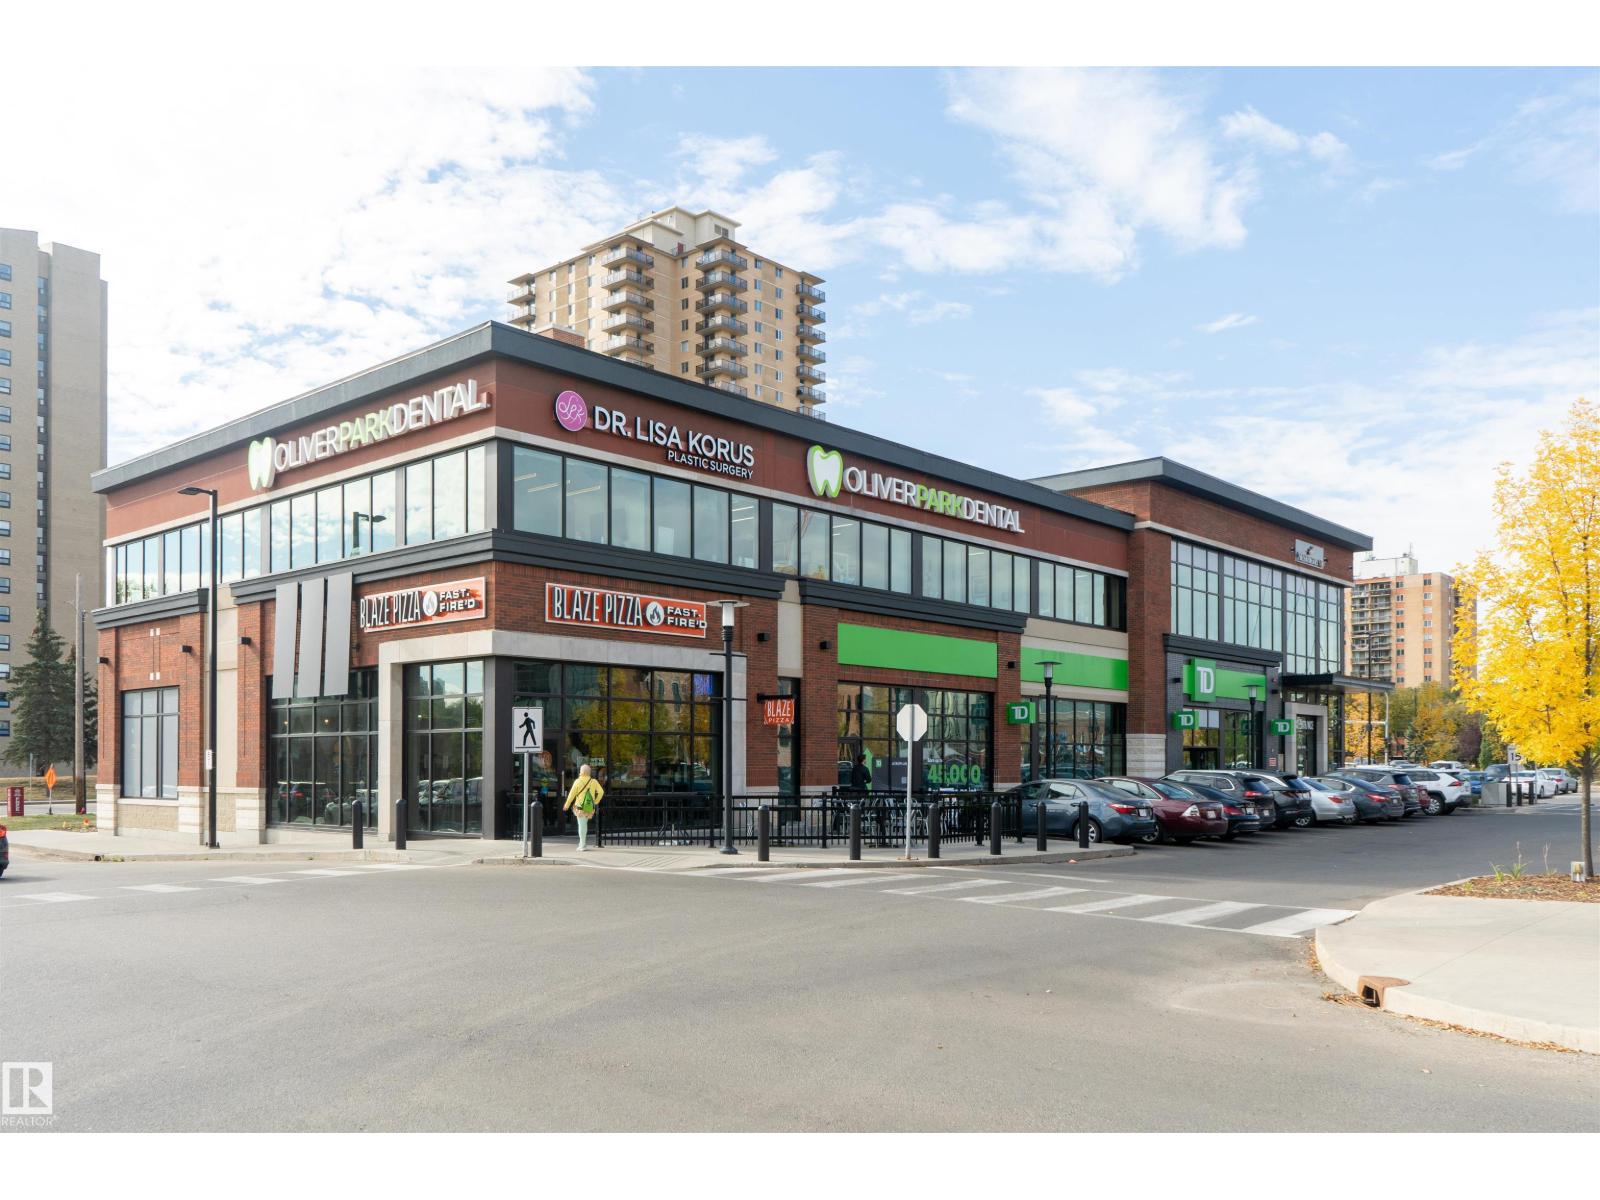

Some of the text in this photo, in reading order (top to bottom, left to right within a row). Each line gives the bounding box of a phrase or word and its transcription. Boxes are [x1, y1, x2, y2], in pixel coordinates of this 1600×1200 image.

[593, 406, 755, 467] DR. LISA KORUS
[668, 451, 753, 479] PLASTIC SURGERY
[360, 591, 421, 628] BLAZE PIZZA
[440, 598, 475, 612] FIRE'D
[554, 586, 643, 627] BLAZE PIZZA
[667, 615, 708, 629] FIRE'D
[1196, 666, 1215, 694] TD
[767, 699, 791, 717] BLAZE
[1011, 705, 1029, 720] TD
[1178, 714, 1194, 726] TD
[1275, 721, 1290, 733] TD
